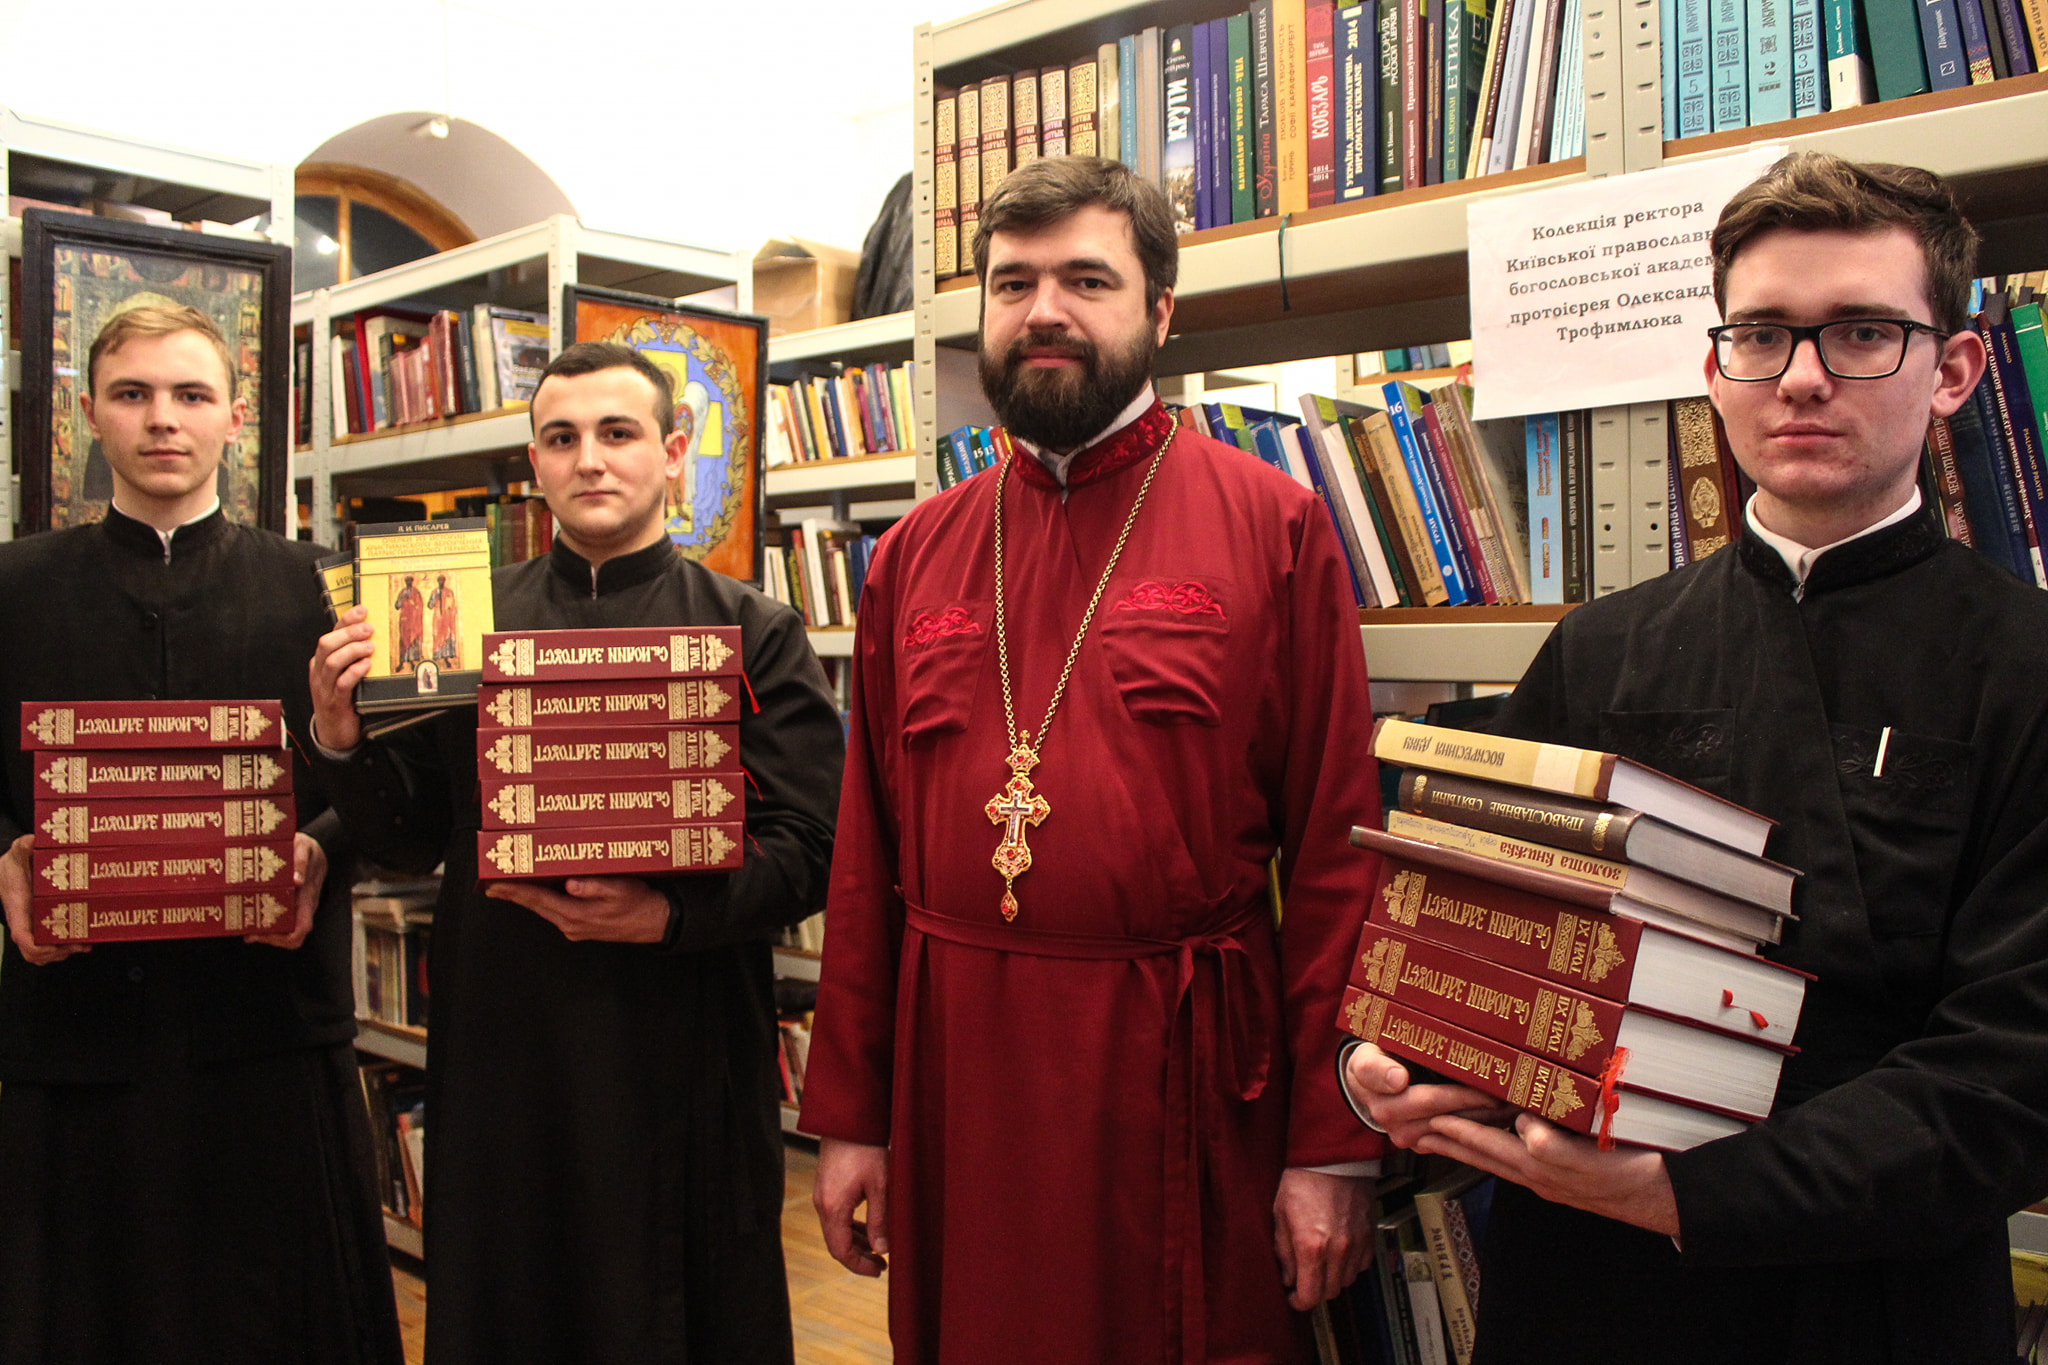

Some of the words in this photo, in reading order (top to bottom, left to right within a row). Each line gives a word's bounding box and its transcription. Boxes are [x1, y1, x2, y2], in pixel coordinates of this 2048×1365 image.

[1347, 19, 1358, 49] 2014
[1382, 18, 1391, 79] ИСТОРИЯ
[1447, 6, 1459, 90] ЕТИКА
[1764, 61, 1776, 76] 2
[1798, 53, 1808, 69] 3
[1353, 62, 1363, 111] UKRAINE
[1689, 79, 1698, 94] 5
[1726, 70, 1732, 83] 1
[1168, 77, 1191, 142] КРУТИ
[1311, 75, 1329, 139] КОБЗАРЬ
[1354, 113, 1363, 174] DIPLOMATIC
[1256, 132, 1275, 199] Україна
[1344, 142, 1354, 187] УКРАЇНА
[1532, 215, 1616, 240] Колекція
[1624, 202, 1704, 227] ректора
[1506, 245, 1596, 273] Київської
[1509, 263, 1641, 296] богословської
[1510, 298, 1611, 326] протоієрея
[1617, 284, 1714, 309] Олександ
[1557, 313, 1683, 342] Трофимлюка
[1981, 329, 1994, 354] ЛЮДУ
[2000, 331, 2013, 363] MANCUSO
[1987, 355, 2002, 389] БОЖОГО
[1390, 401, 1403, 415] 16
[973, 447, 984, 459] 15
[2023, 428, 2034, 453] PSALMS
[2027, 453, 2039, 470] AND
[2032, 471, 2044, 499] PRAYERS
[2017, 479, 2033, 519] Христофор
[414, 523, 450, 532] ПИСАРЕВ
[1426, 516, 1443, 544] ТРУДИ
[689, 647, 701, 669] ТОМ
[687, 696, 699, 719] ТОМ
[229, 716, 240, 739] ТОМ
[687, 731, 698, 743] IX
[687, 745, 698, 768] ТОМ
[1434, 741, 1505, 767] ВОСКРЕСІННЯ
[242, 767, 253, 789] ТОМ
[691, 791, 702, 813] ТОМ
[1431, 790, 1484, 812] СВЯТЫНИ
[244, 816, 255, 836] ТОМ
[1489, 801, 1585, 831] ПРАВОСЛАВНЫЕ
[691, 842, 702, 865] ТОМ
[1500, 841, 1555, 867] книжка
[243, 860, 254, 881] ТОМ
[1560, 856, 1622, 881] золота
[244, 896, 254, 904] X
[244, 906, 255, 928] ТОМ
[1579, 918, 1592, 939] XI
[1569, 941, 1590, 976] ТОМ
[1555, 995, 1571, 1017] XII
[1547, 1018, 1566, 1055] ТОМ
[1528, 1082, 1547, 1108] ТОМ
[1538, 1065, 1551, 1085] XII
